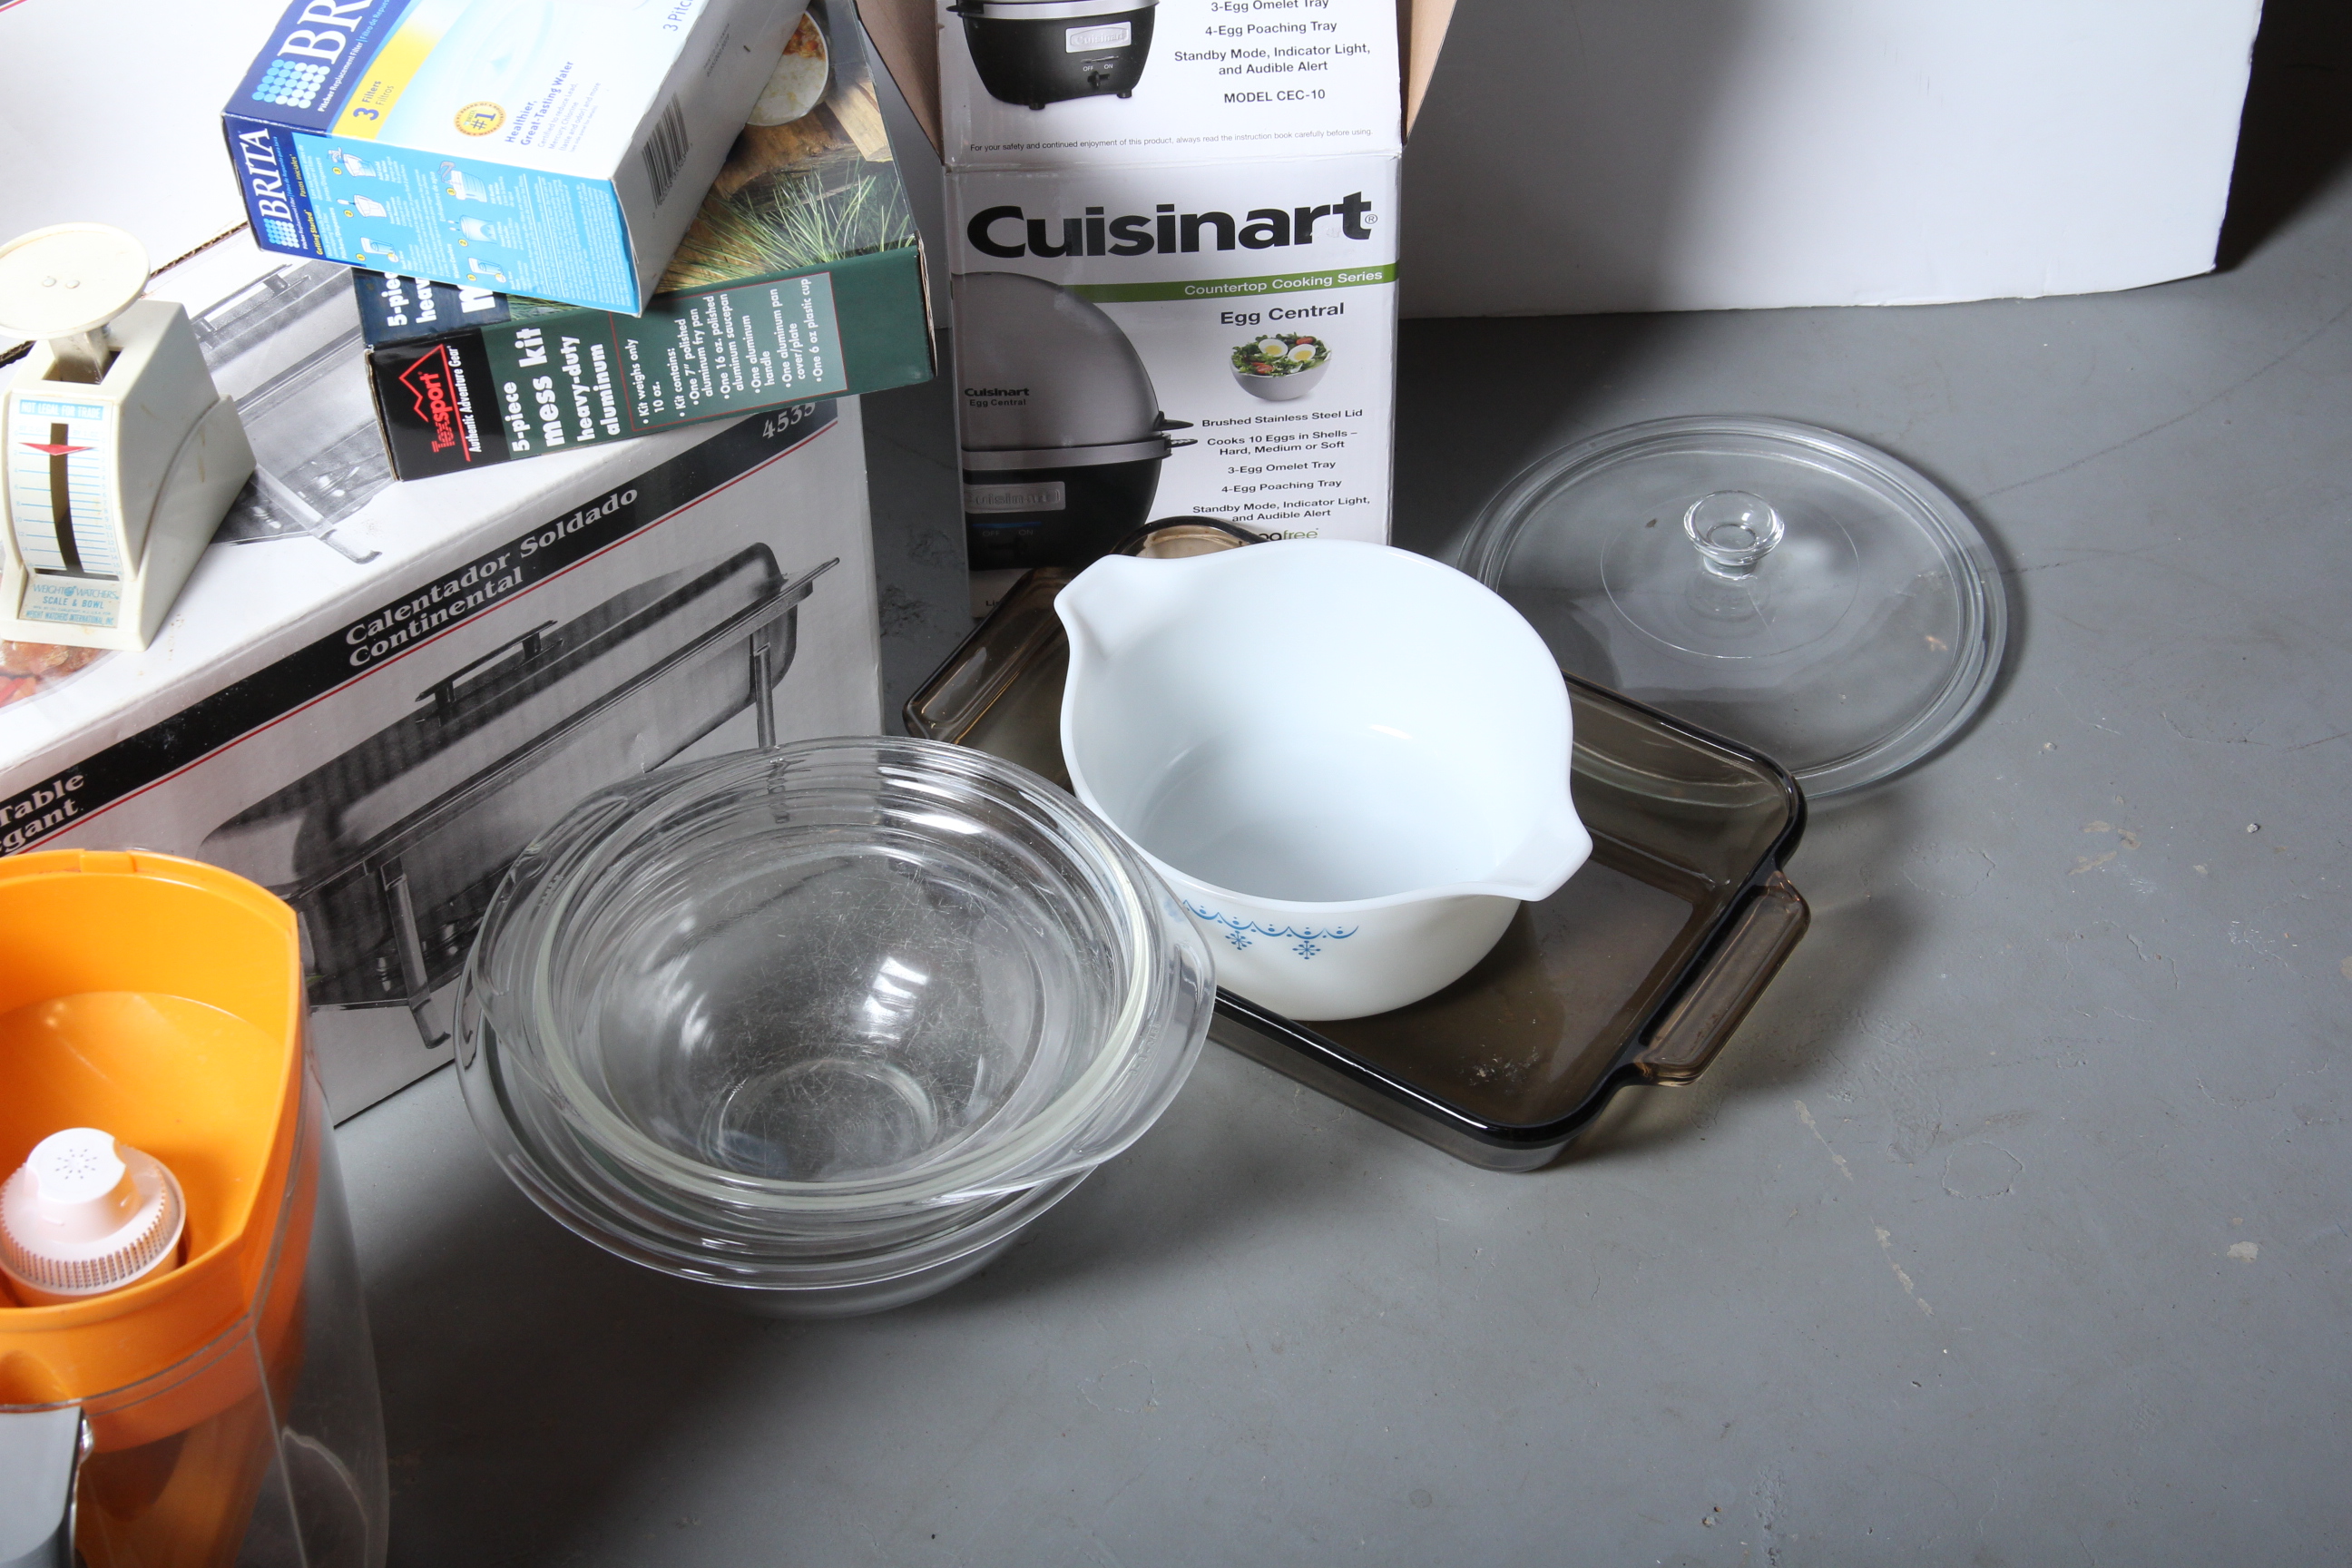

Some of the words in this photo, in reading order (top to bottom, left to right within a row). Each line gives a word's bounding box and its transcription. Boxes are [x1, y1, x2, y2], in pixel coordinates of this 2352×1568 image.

[667, 0, 693, 22] Pitc
[1210, 1, 1249, 13] 3-Egg
[1253, 0, 1298, 10] Omelet
[662, 24, 679, 32] 3
[1206, 25, 1243, 37] 4-Egg
[1248, 23, 1307, 34] Poaching
[1310, 21, 1338, 32] Tray
[1174, 51, 1227, 61] Standby
[1231, 49, 1270, 60] Mode,
[1274, 46, 1330, 56] Indicator
[1335, 44, 1370, 55] Light,
[318, 90, 335, 112] Pitcher
[329, 55, 357, 93] Replacement
[349, 42, 363, 58] Filter
[1219, 64, 1242, 75] and
[1247, 64, 1293, 74] Audible
[1298, 61, 1328, 72] Alert
[362, 81, 382, 103] Filters
[376, 85, 394, 106] Filtros
[1224, 92, 1272, 103] MODEL
[1277, 89, 1325, 101] CEC-10
[353, 107, 379, 121] 3
[521, 87, 562, 146] Great-Tasting
[551, 61, 573, 86] Water
[470, 113, 496, 130] #1
[505, 100, 538, 143] Healthier,
[1003, 142, 1024, 151] safety
[1043, 141, 1078, 149] continued
[1081, 140, 1117, 148] enjoyment
[1144, 137, 1173, 145] product,
[1177, 135, 1200, 144] always
[1234, 132, 1271, 141] instruction
[1295, 130, 1324, 138] carefully
[1352, 128, 1373, 137] using.
[239, 128, 293, 222] BRITA
[291, 156, 301, 180] iniciales
[298, 181, 307, 197] Pasos
[292, 207, 303, 233] Replacement
[305, 211, 317, 233] Started
[967, 191, 1372, 259] Cuisinart
[312, 234, 323, 254] Getting
[800, 279, 811, 295] cup
[1185, 282, 1267, 296] Countertop
[1272, 276, 1332, 289] Cooking
[1338, 271, 1383, 283] Series
[381, 272, 409, 327] 5-piec
[770, 289, 782, 307] pan
[691, 309, 703, 327] pan
[703, 296, 722, 335] polished
[720, 294, 734, 338] saucepan
[801, 298, 818, 328] plastic
[1221, 312, 1260, 327] Egg
[1269, 302, 1344, 320] Central
[675, 319, 695, 359] polished
[692, 330, 705, 345] fry
[742, 316, 757, 363] aluminum
[774, 310, 788, 358] aluminum
[809, 331, 818, 343] oz
[515, 328, 546, 367] kit
[624, 339, 638, 360] only
[715, 338, 723, 353] oz.
[789, 323, 805, 379] cover/plate
[448, 348, 461, 367] Gear
[715, 356, 726, 368] 16
[729, 341, 743, 390] aluminum
[812, 356, 823, 377] One
[667, 348, 682, 392] contains:
[698, 347, 713, 397] aluminum
[751, 367, 761, 387] One
[760, 351, 775, 386] handle
[782, 361, 791, 382] One
[454, 368, 472, 412] Adventure
[561, 338, 594, 440] heavy-duty
[592, 345, 619, 434] aluminum
[631, 363, 645, 399] weighs
[652, 381, 662, 397] oz.
[690, 378, 700, 399] One
[720, 372, 730, 394] One
[674, 396, 686, 409] Kit
[965, 388, 1030, 397] Cuisinart
[970, 399, 988, 407] Egg
[991, 398, 1025, 407] Central
[22, 401, 35, 414] NOT
[38, 403, 59, 416] LEGAL
[62, 405, 74, 416] FOR
[78, 407, 101, 418] TRADE
[420, 374, 455, 451] Texsport
[534, 377, 564, 446] mess
[637, 402, 649, 416] Kit
[652, 399, 664, 412] 10
[505, 382, 530, 451] 5-piece
[762, 402, 816, 439] 4535
[1202, 417, 1251, 426] Brushed
[1255, 414, 1308, 424] Stainless
[1312, 411, 1341, 420] Steel
[1345, 409, 1363, 417] Lid
[463, 415, 481, 452] Authentic
[1208, 436, 1245, 446] Cooks
[1250, 436, 1262, 444] 10
[1266, 434, 1295, 444] Eggs
[1313, 430, 1348, 439] Shells
[1220, 447, 1250, 456] Hard,
[1255, 444, 1301, 454] Medium
[1321, 441, 1345, 449] Soft
[1228, 466, 1262, 474] 3-Egg
[1266, 462, 1308, 472] Omelet
[1311, 461, 1336, 469] Tray
[1221, 485, 1256, 494] 4-Egg
[1260, 481, 1314, 491] Poaching
[1318, 480, 1342, 488] Tray
[1193, 505, 1240, 514] Standby
[1244, 502, 1279, 511] Mode,
[1283, 499, 1335, 508] Indicator
[1338, 496, 1370, 505] Light,
[1232, 514, 1253, 522] and
[1257, 511, 1300, 521] Audible
[1304, 509, 1331, 518] Alert
[1259, 530, 1318, 541] afree
[346, 553, 511, 645] Calentador
[520, 489, 638, 559] Soldado
[34, 584, 64, 594] WEIGHT
[76, 587, 117, 599] WATCHERS
[43, 596, 67, 605] SCALE
[83, 600, 103, 609] BOWL
[349, 566, 524, 667] Continental
[0, 775, 84, 828] Table
[0, 799, 78, 853] gant
